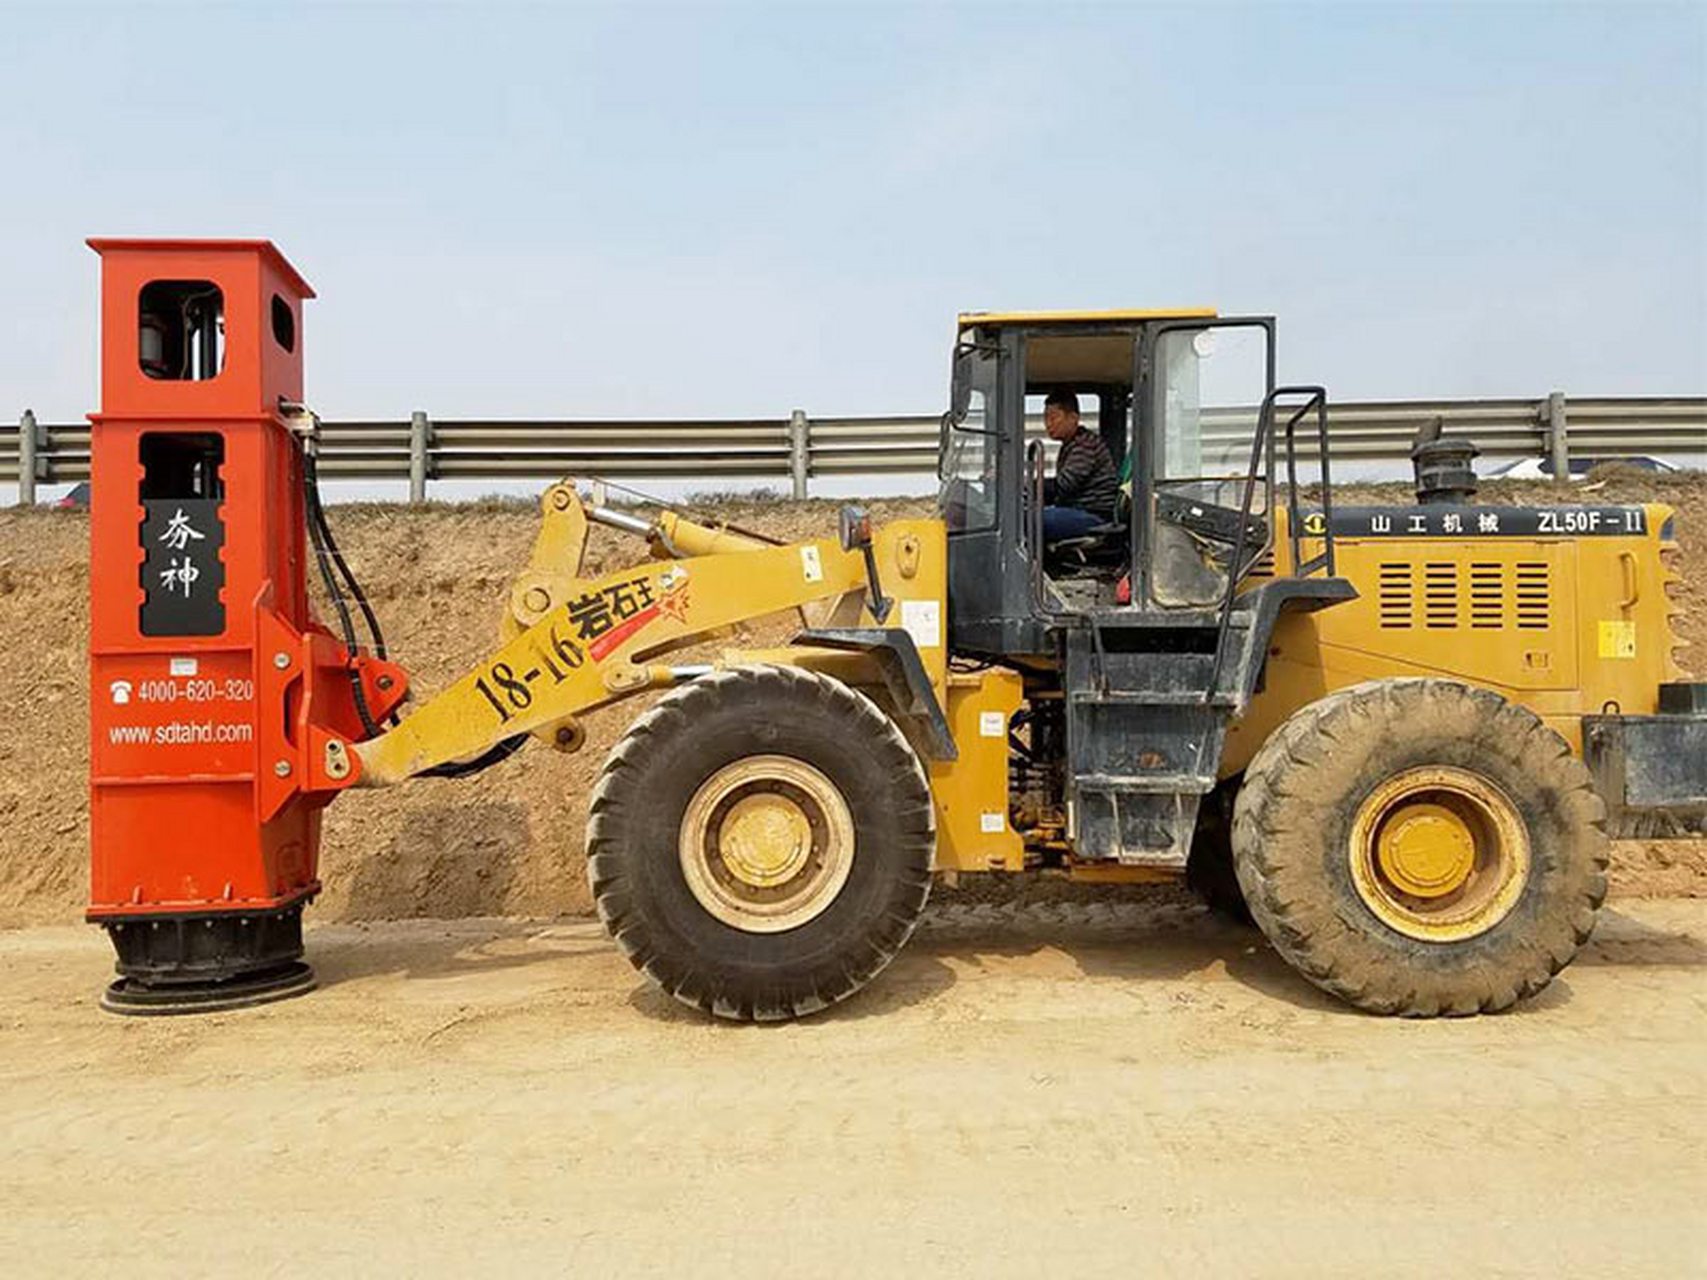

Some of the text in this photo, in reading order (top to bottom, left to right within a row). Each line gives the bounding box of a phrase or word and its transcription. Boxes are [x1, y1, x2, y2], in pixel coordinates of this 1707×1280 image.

[1371, 513, 1500, 532] 山工机械
[159, 508, 205, 598] 夯神
[566, 576, 656, 640] 岩石王
[138, 680, 253, 701] 4000-620-320
[475, 623, 585, 723] 18-16
[109, 722, 253, 744] www.sdtahd.com
